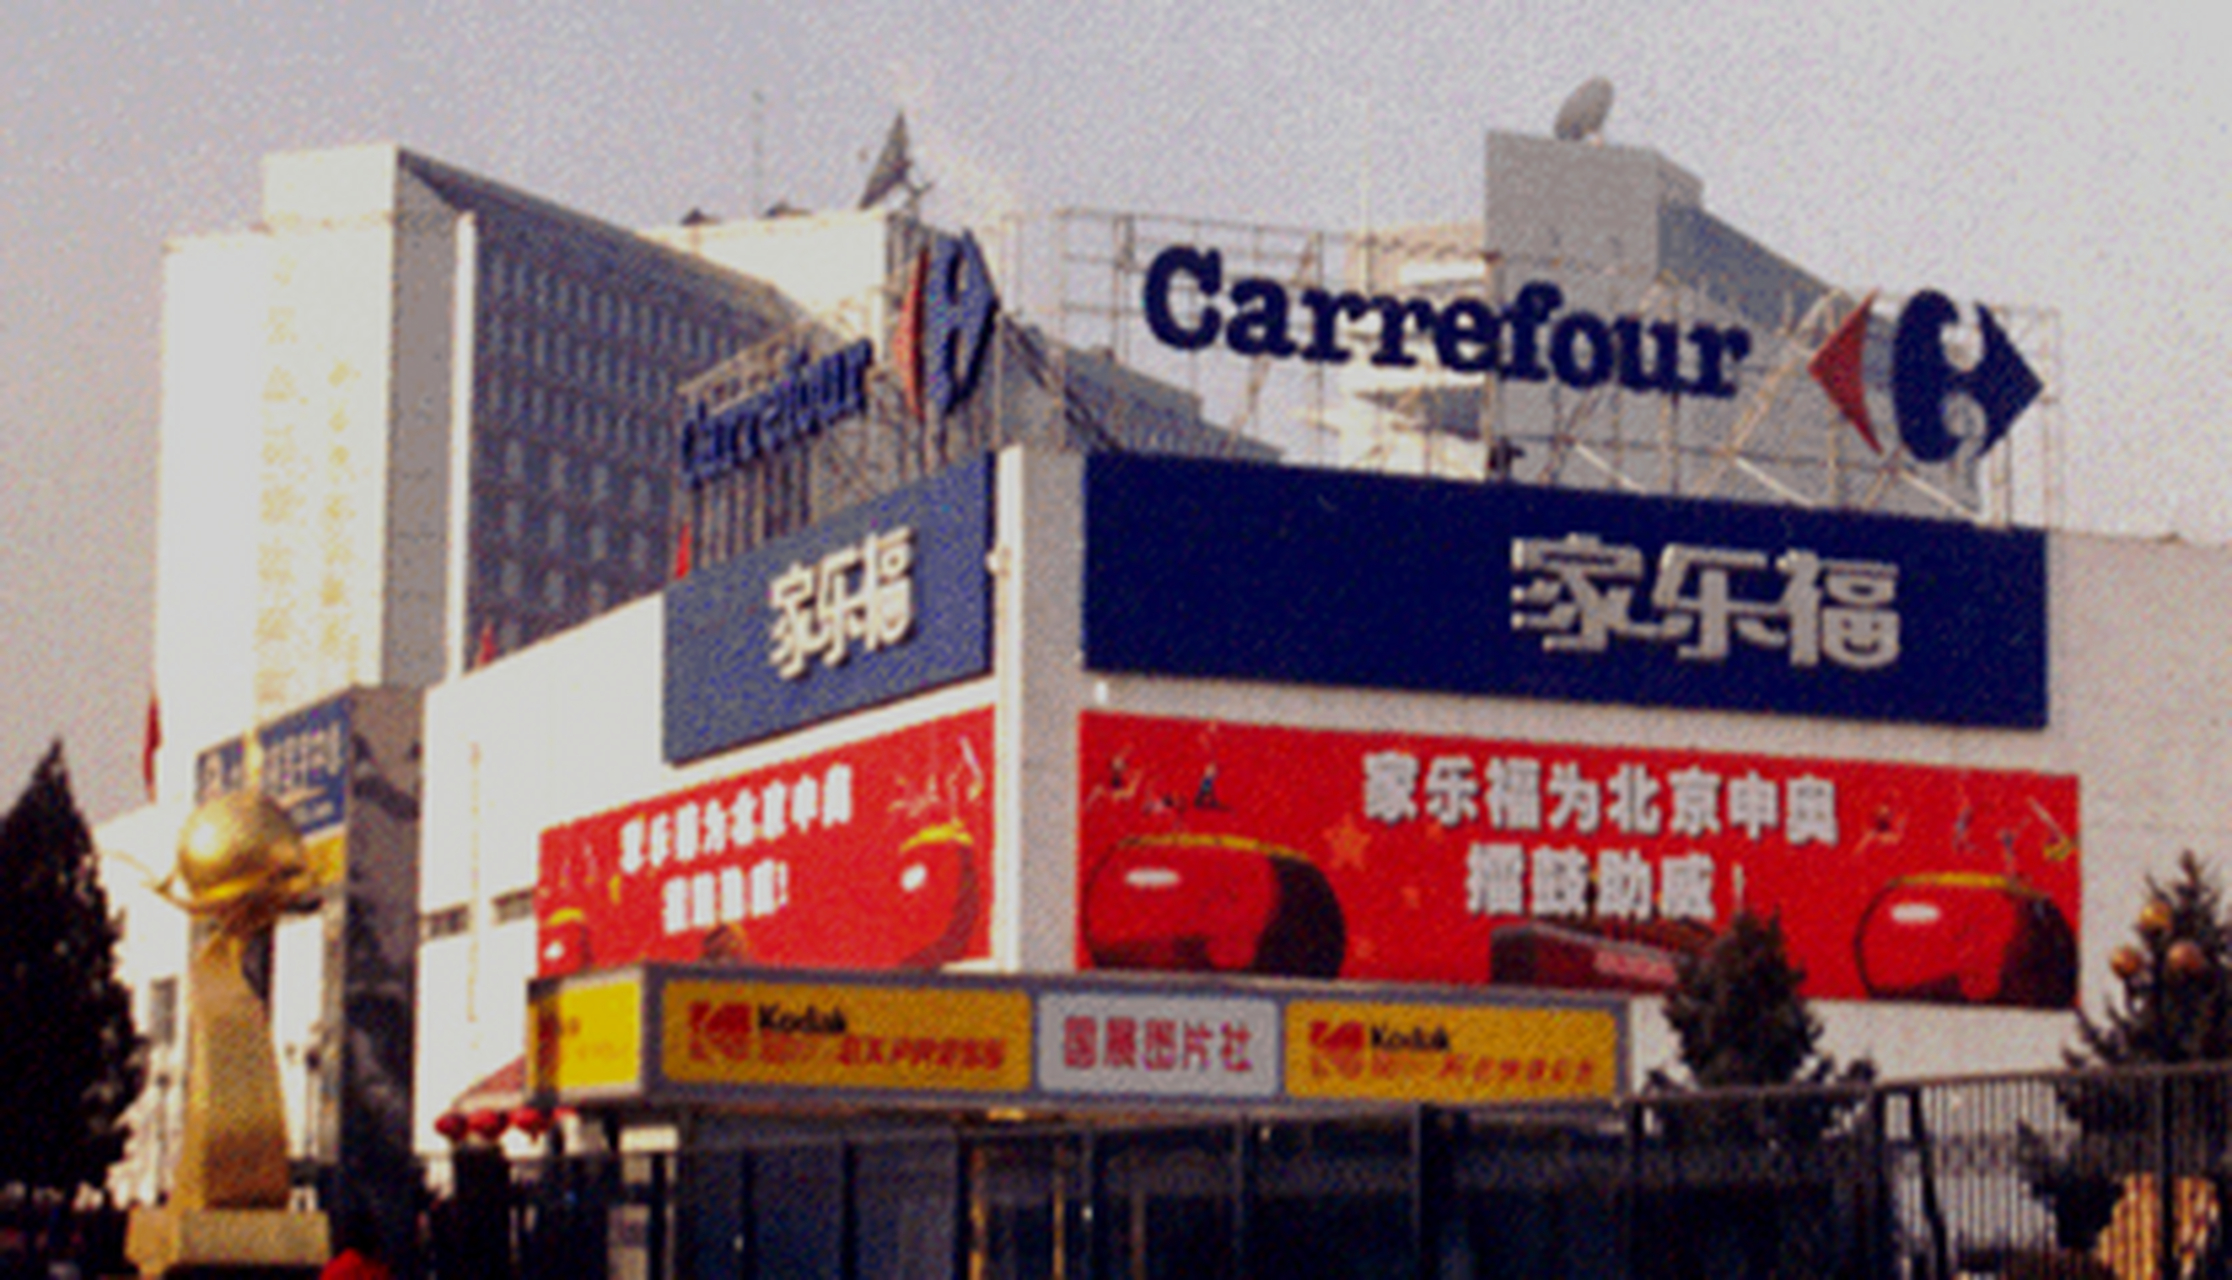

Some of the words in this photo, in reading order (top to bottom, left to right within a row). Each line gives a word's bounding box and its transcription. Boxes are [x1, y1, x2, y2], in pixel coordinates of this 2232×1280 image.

[1142, 245, 1753, 399] Carrefour
[769, 525, 914, 680] 家乐福
[1511, 531, 1901, 670] 家乐福
[1363, 749, 1837, 846] 家乐福为北京申奥
[758, 1002, 847, 1033] Kodak
[1370, 1022, 1451, 1052] Kodak
